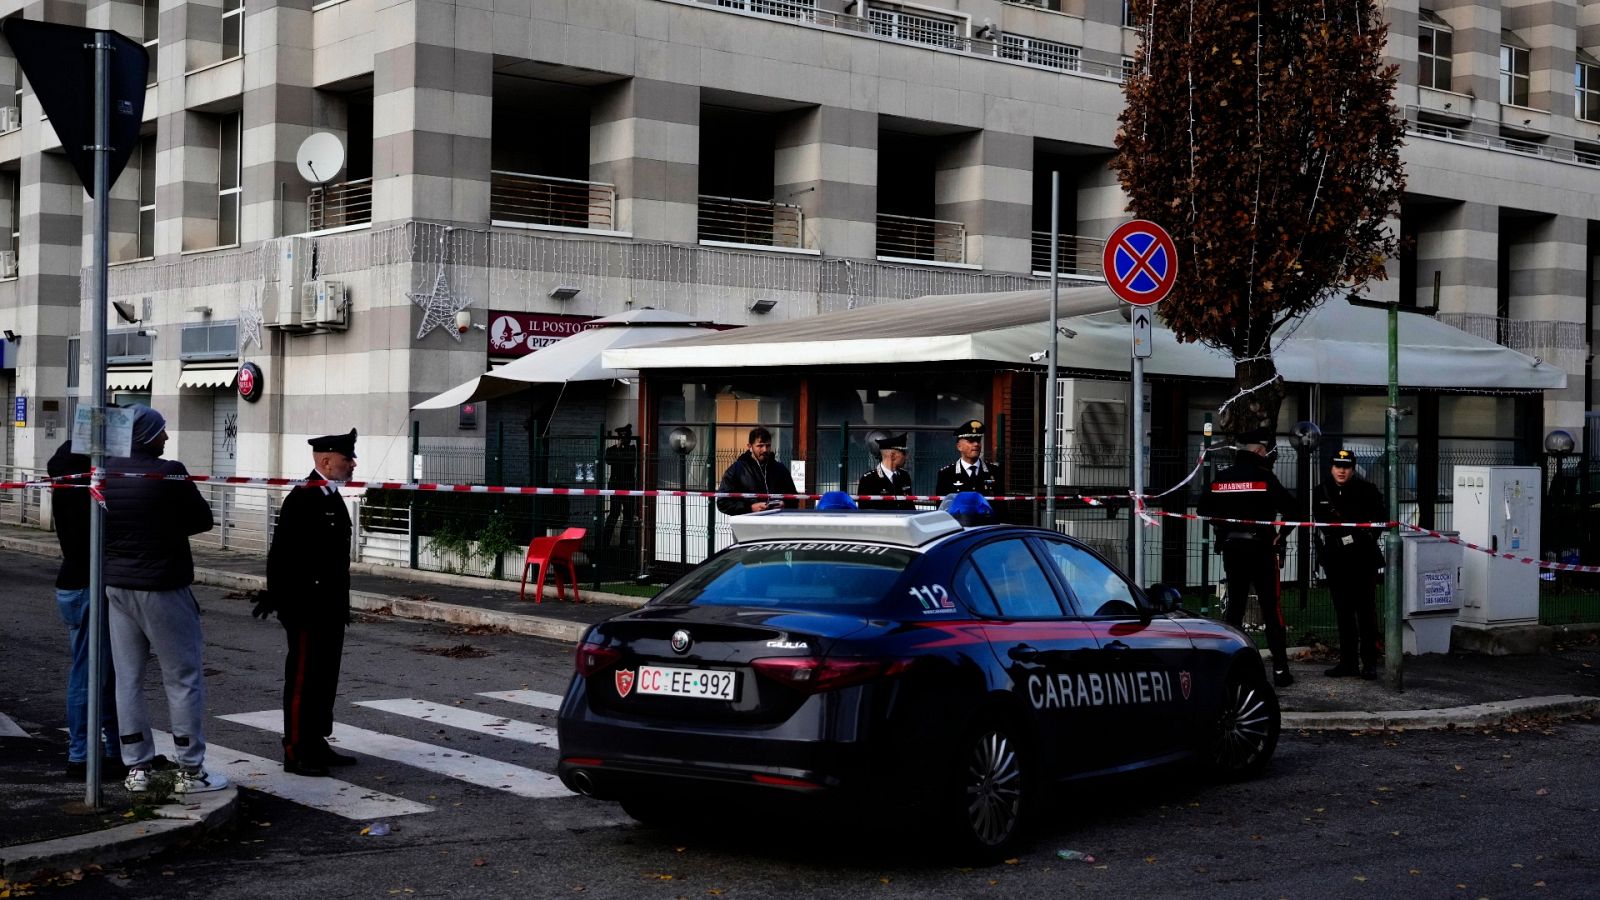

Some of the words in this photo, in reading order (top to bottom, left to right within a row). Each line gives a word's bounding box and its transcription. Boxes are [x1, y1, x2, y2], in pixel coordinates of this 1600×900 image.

[529, 320, 540, 331] IL
[542, 321, 581, 333] POSTO
[1218, 482, 1253, 490] CARABINIERI
[746, 543, 891, 557] CARABINIERI
[908, 583, 956, 609] 112
[766, 641, 808, 649] GIULIA
[641, 669, 661, 691] CC
[671, 671, 693, 693] EE
[699, 673, 731, 696] 992
[1028, 670, 1173, 710] CARABINIERI
